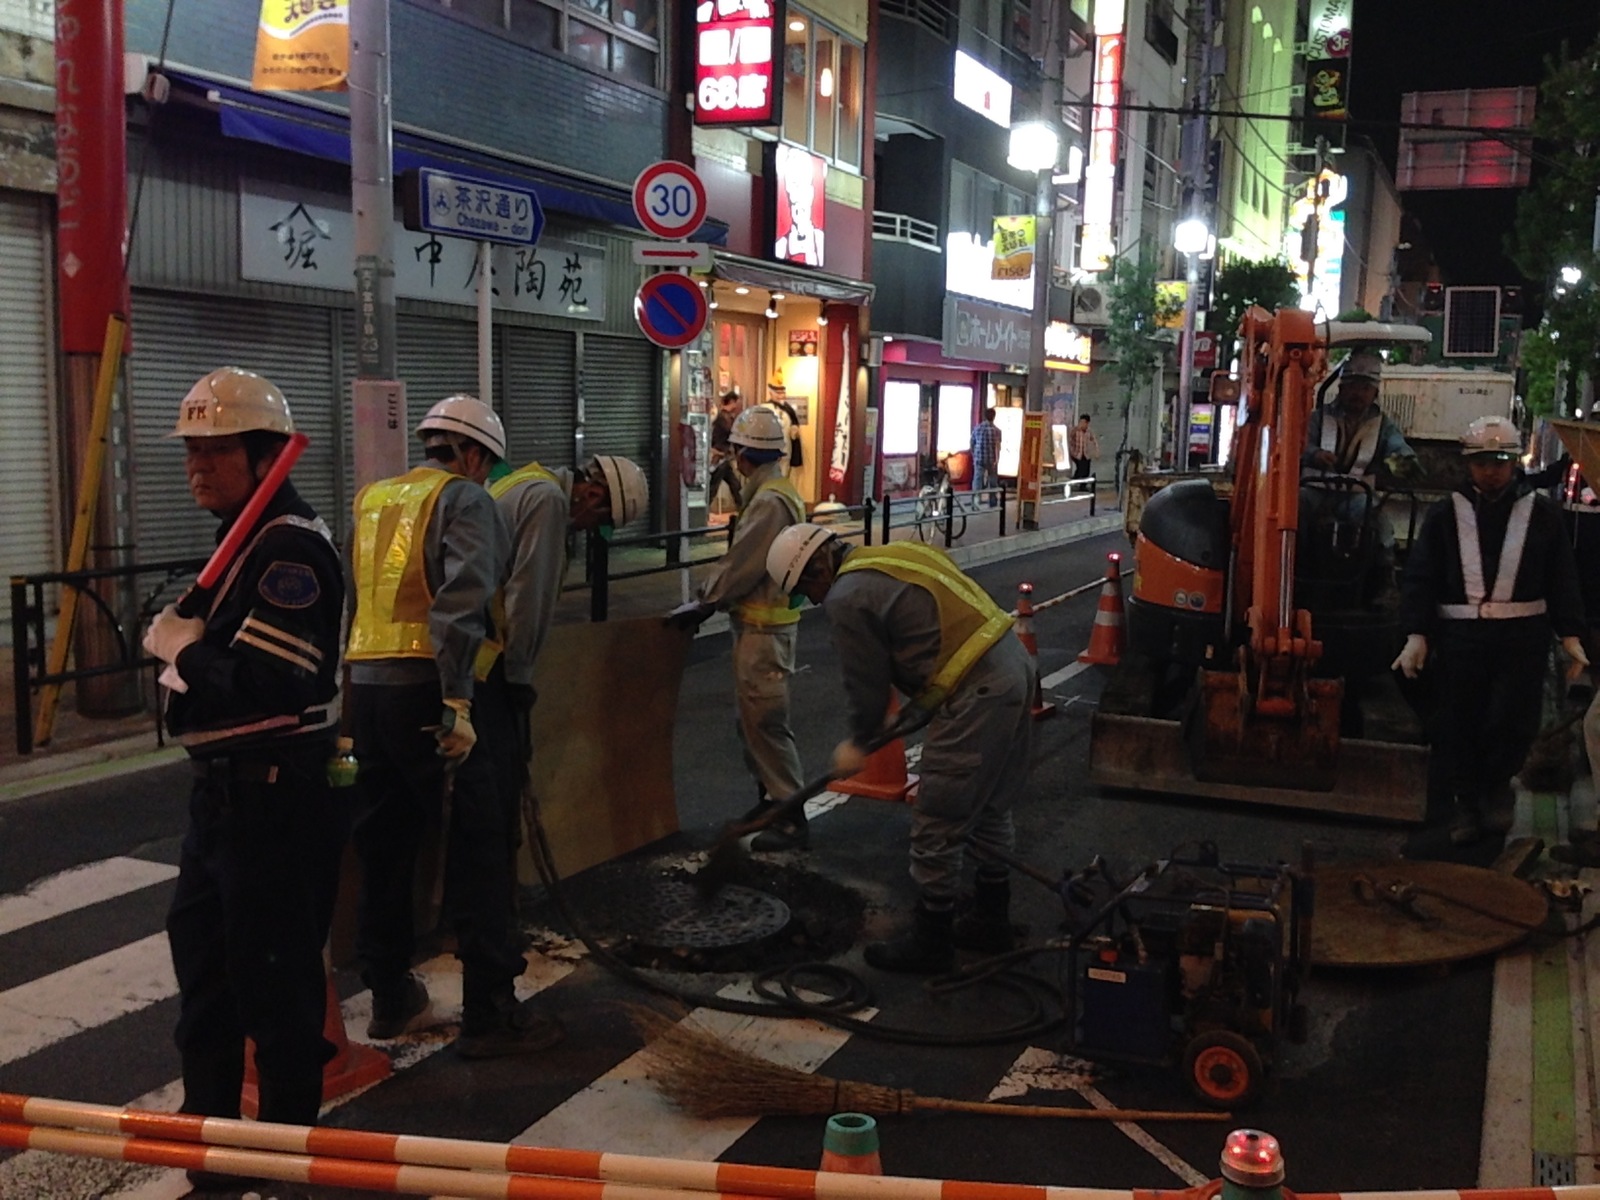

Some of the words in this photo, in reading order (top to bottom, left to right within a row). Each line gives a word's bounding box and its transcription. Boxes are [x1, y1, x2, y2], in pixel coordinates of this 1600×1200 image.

[1331, 34, 1350, 51] 3F
[455, 185, 529, 221] 茶沢通り
[652, 184, 691, 217] 30
[361, 338, 379, 351] 23
[187, 405, 207, 421] FK
